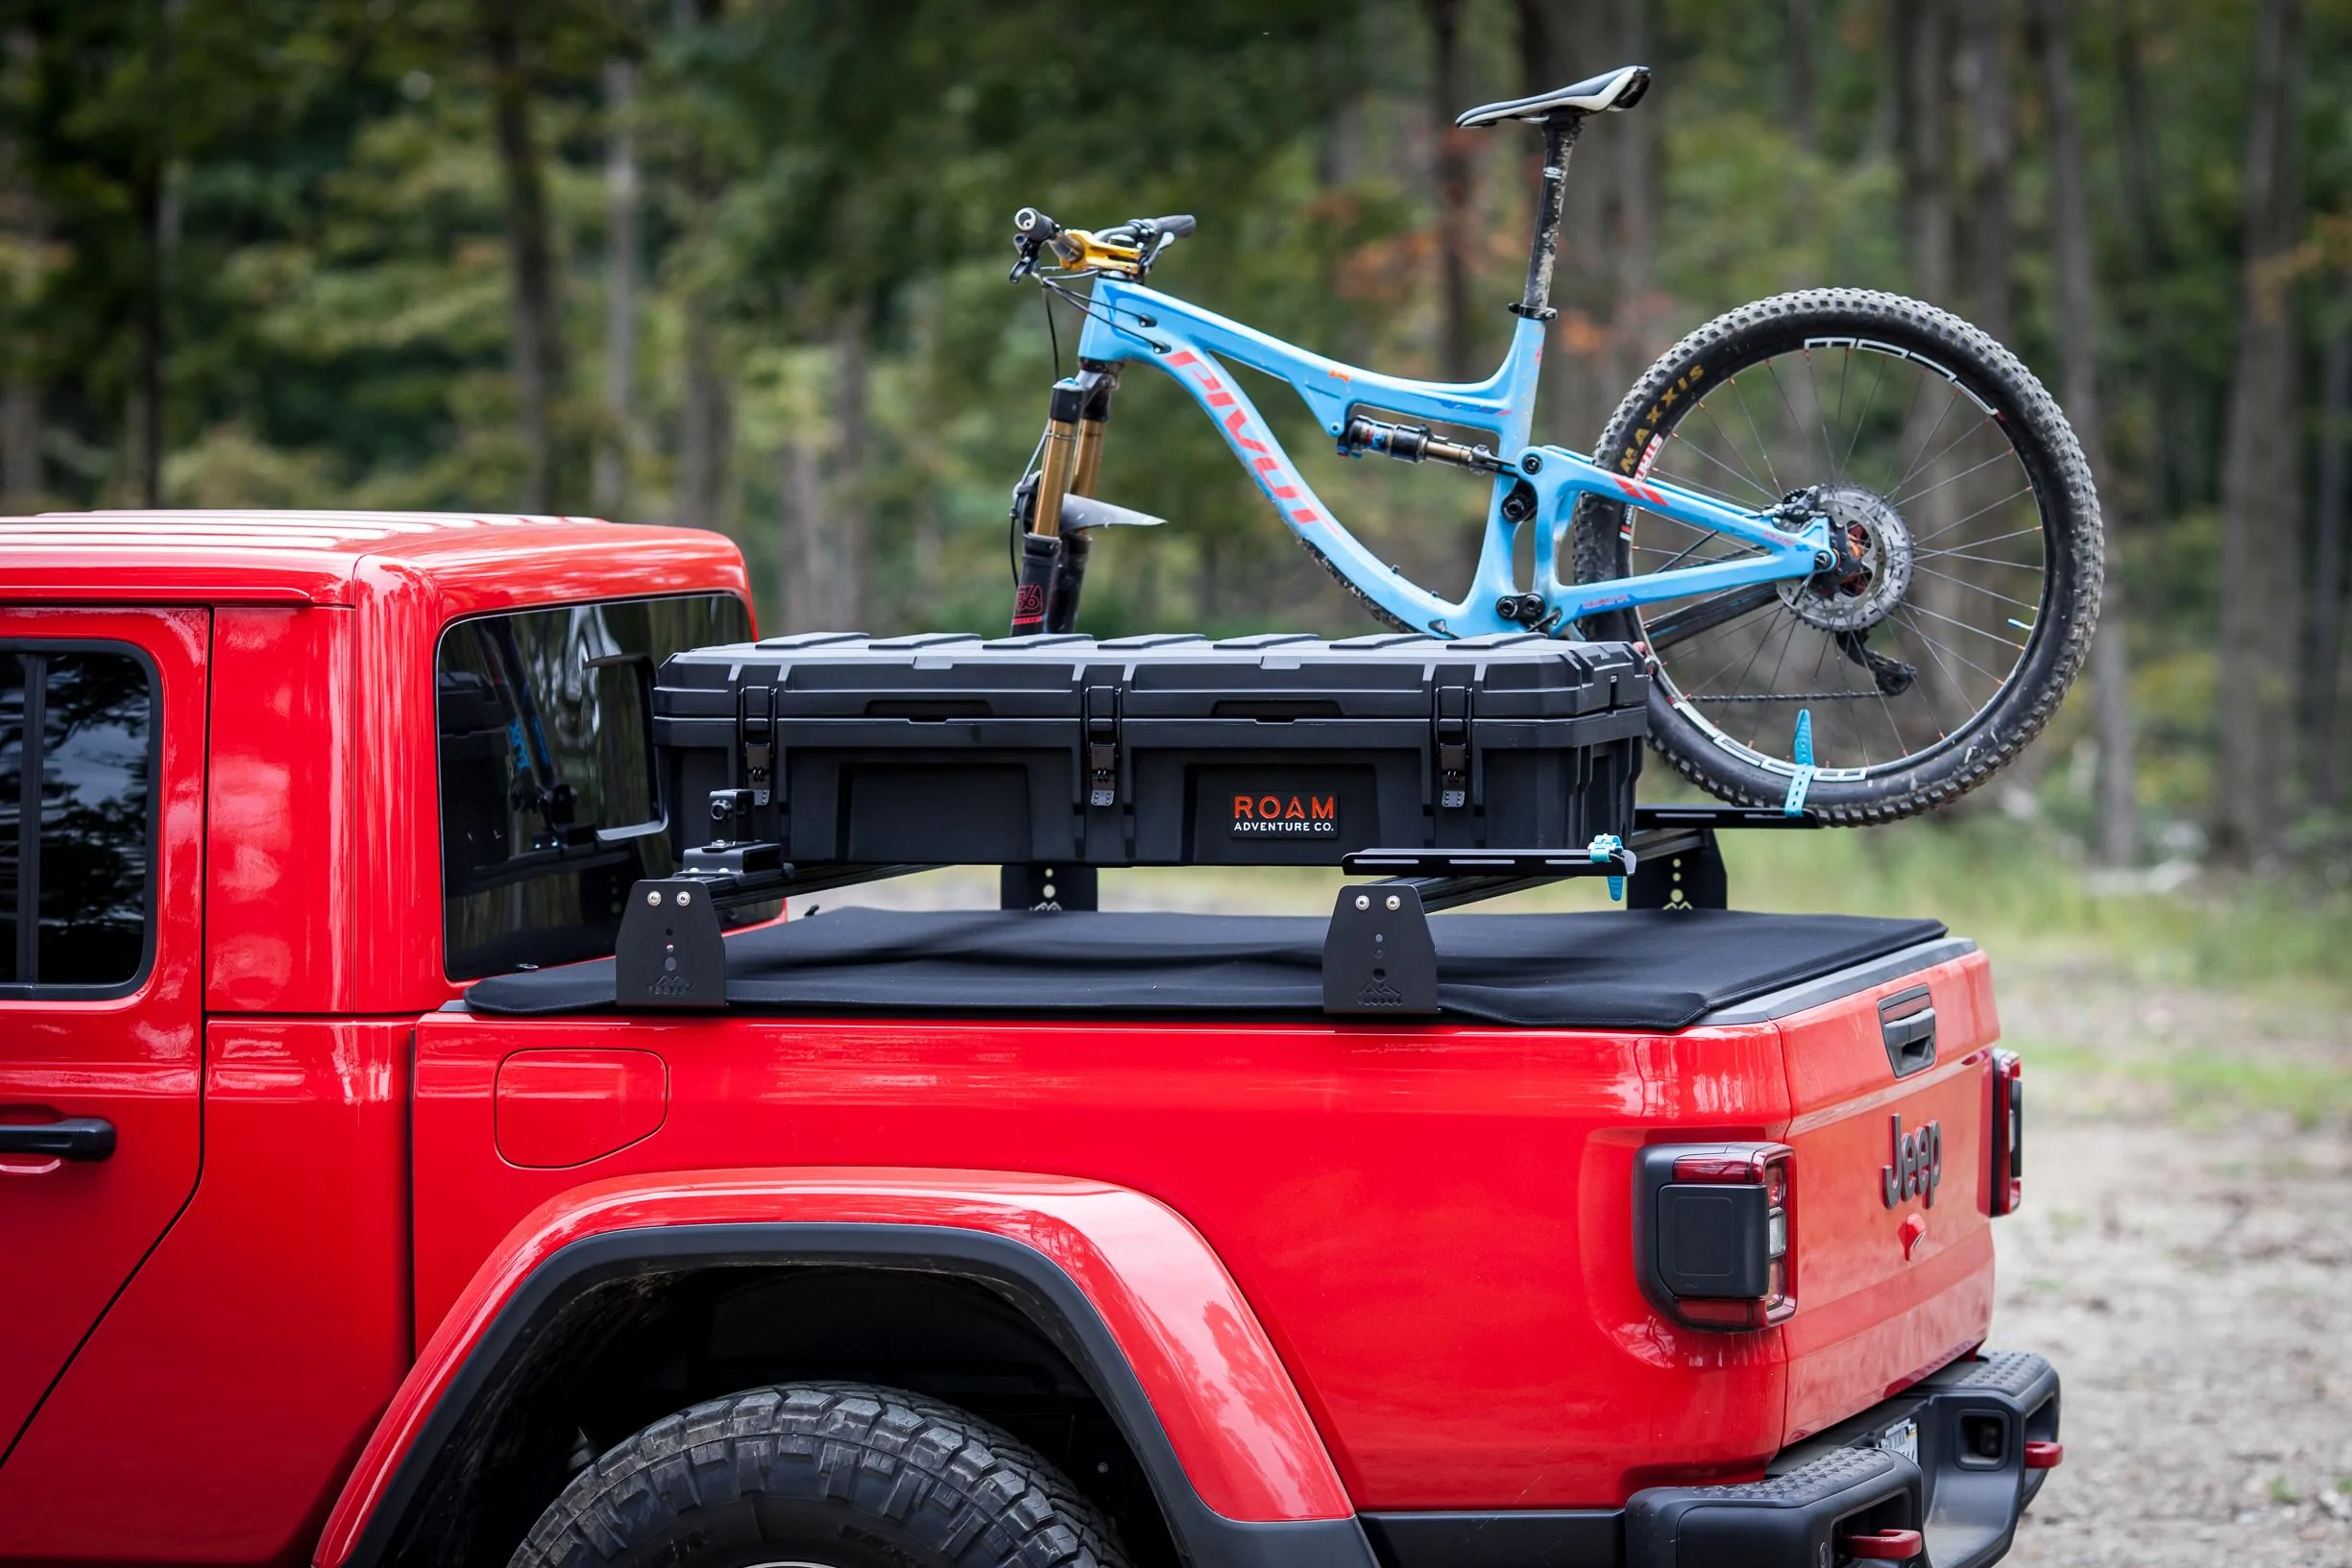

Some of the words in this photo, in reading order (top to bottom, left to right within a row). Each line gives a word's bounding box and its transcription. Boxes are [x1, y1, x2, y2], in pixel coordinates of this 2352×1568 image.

[1164, 350, 1341, 536] PIVOT
[1620, 364, 1705, 474] MAXXIS
[1634, 433, 1663, 481] STAN
[1234, 796, 1334, 819] ROAM
[1234, 822, 1310, 832] ADVENTURE
[1314, 822, 1334, 832] CO.
[1879, 1113, 1941, 1210] Jeep
